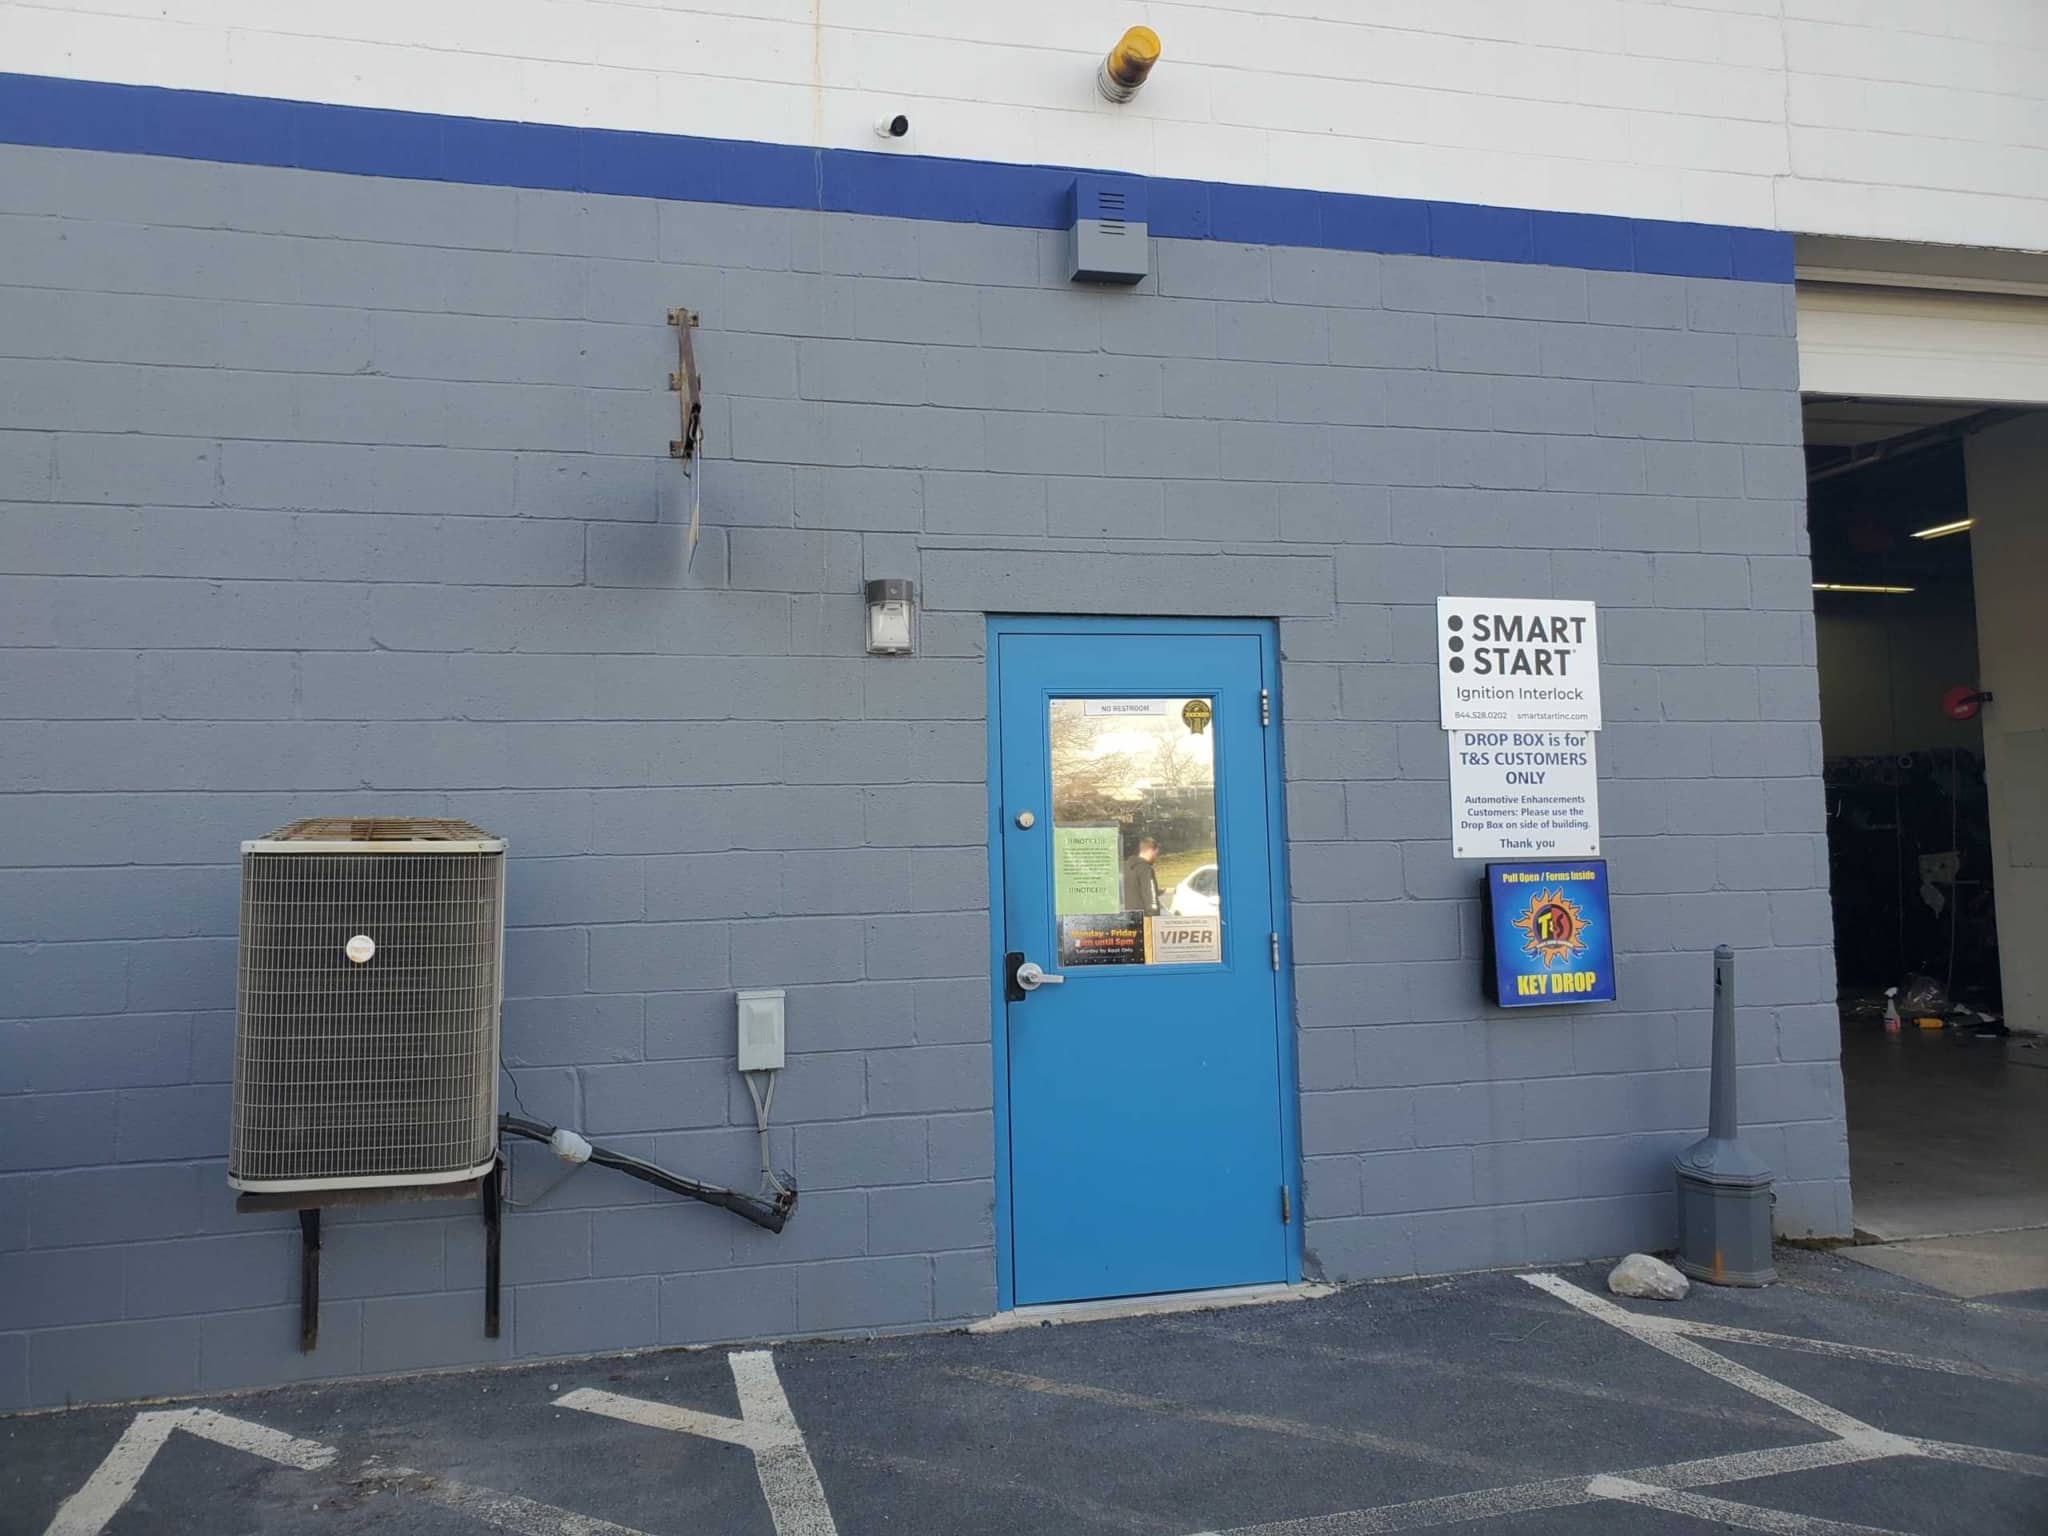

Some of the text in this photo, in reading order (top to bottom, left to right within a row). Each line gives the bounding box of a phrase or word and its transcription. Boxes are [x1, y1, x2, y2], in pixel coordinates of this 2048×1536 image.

[1472, 614, 1586, 644] SMART
[1473, 647, 1571, 676] START
[1456, 686, 1584, 702] Ignition Interlock
[1113, 704, 1150, 712] RESTROOM
[1454, 711, 1589, 721] 844.528.0202 smartstartinc.com
[1464, 733, 1587, 747] DROP BOX is for
[1460, 752, 1588, 766] T&S CUSTOMERS
[1505, 771, 1546, 785] ONLY
[1464, 795, 1586, 804] Automotive Enhancements
[1467, 808, 1585, 817] Customers: Please use the
[1461, 821, 1484, 831] Drop
[1486, 821, 1503, 829] Box
[1519, 820, 1538, 829] side
[1540, 820, 1550, 829] of
[1552, 820, 1591, 831] building.
[1499, 838, 1556, 851] Thank you
[1502, 873, 1518, 883] Pull
[1519, 873, 1540, 883] Open
[1545, 872, 1570, 882] Forms
[1571, 871, 1596, 881] Inside
[1071, 929, 1104, 938] nday
[1110, 929, 1138, 938] Friday
[1160, 930, 1213, 944] VIPER
[1094, 938, 1114, 946] until
[1517, 971, 1597, 996] KEY DROP
